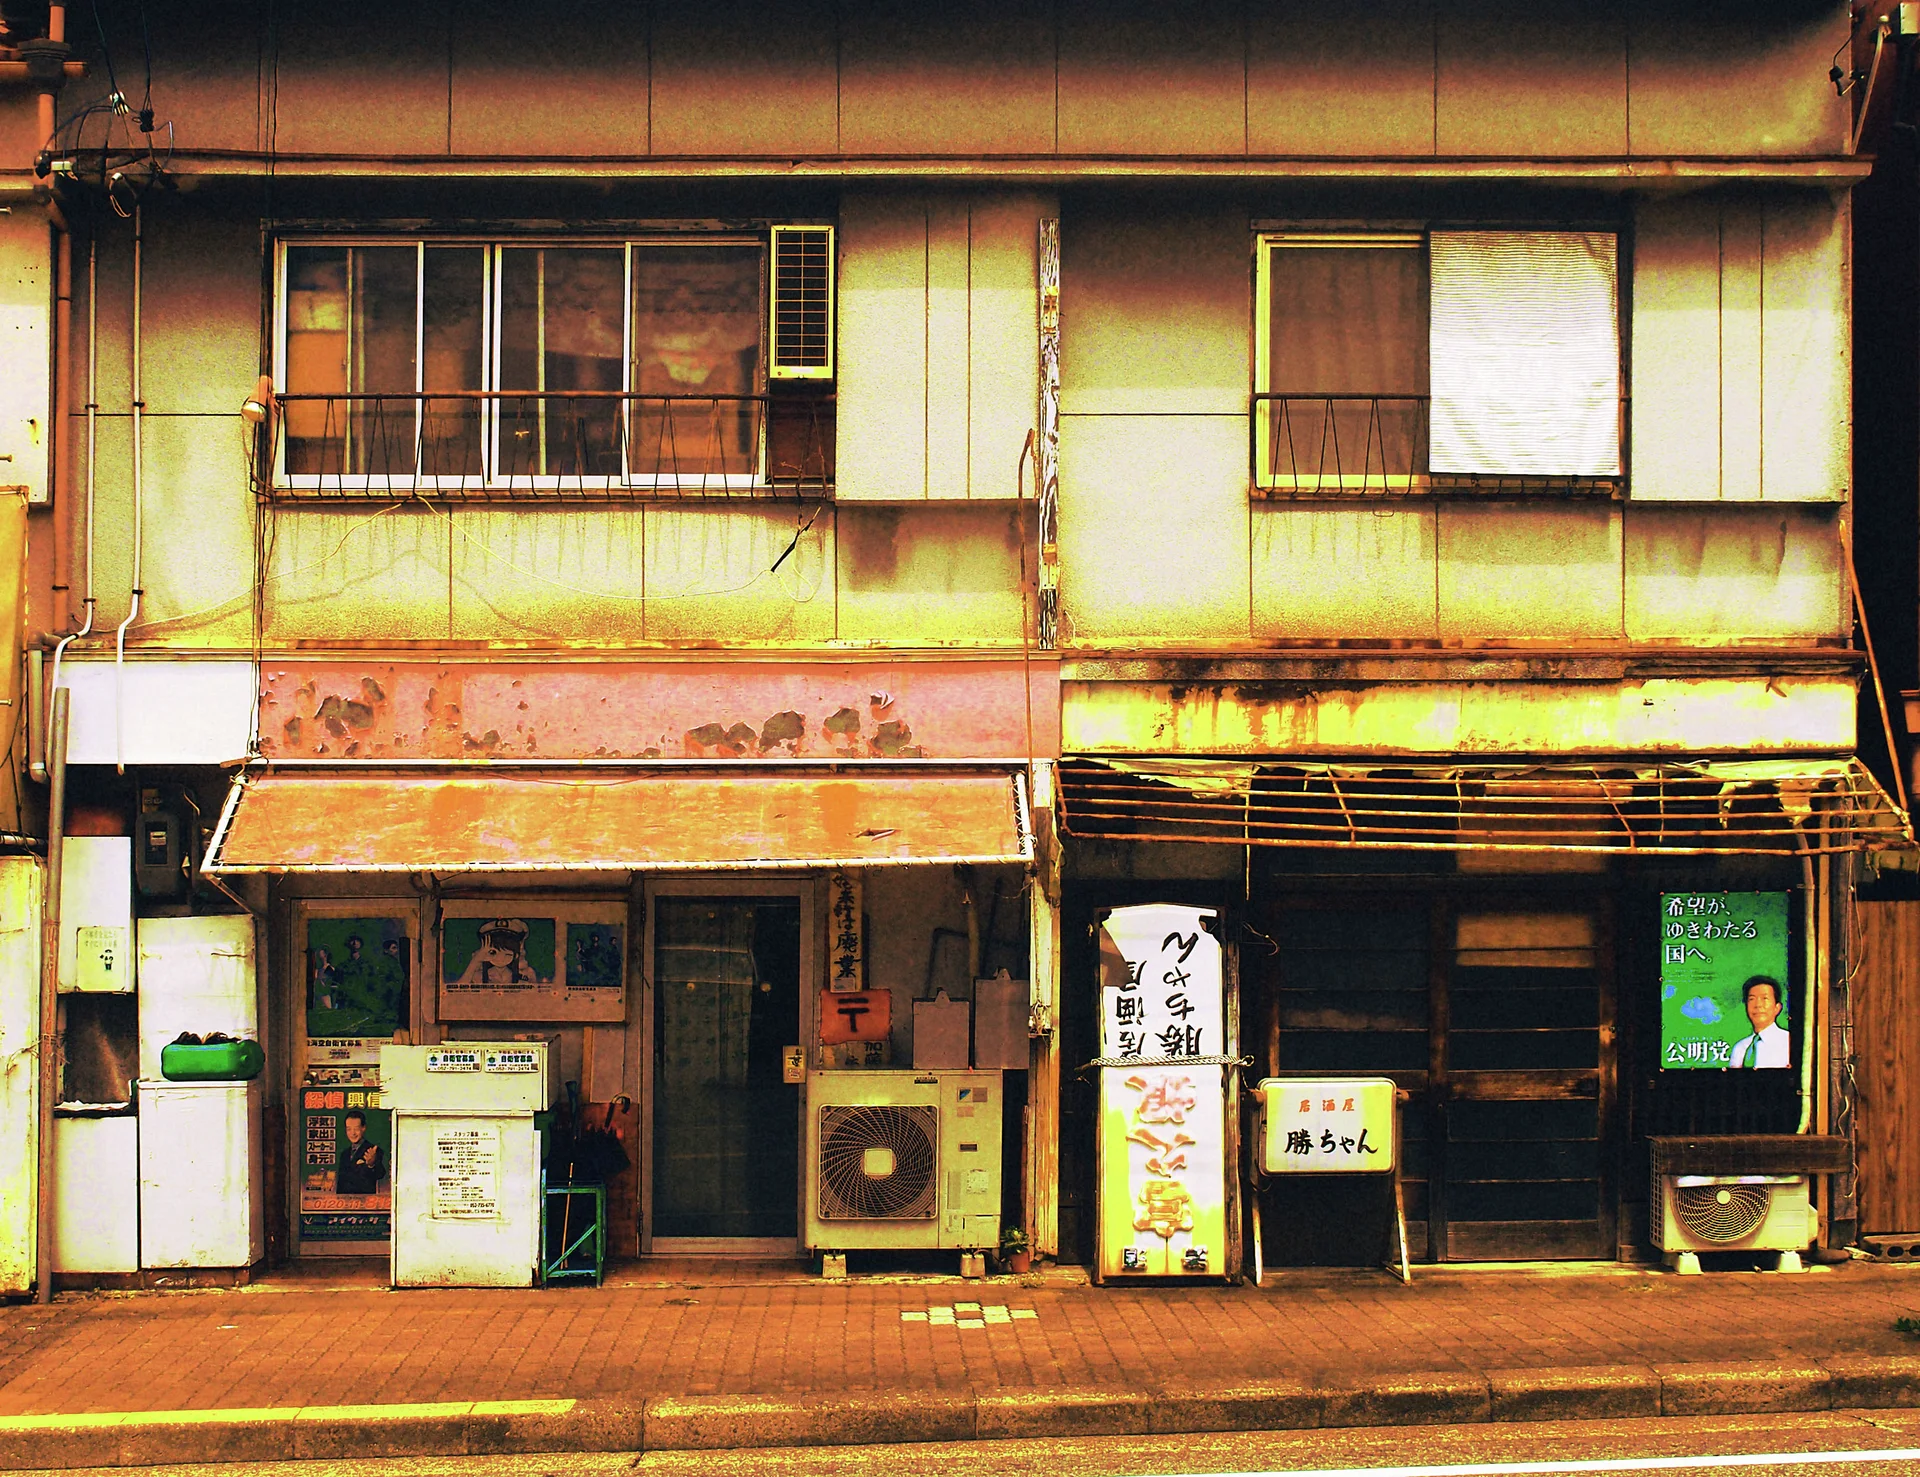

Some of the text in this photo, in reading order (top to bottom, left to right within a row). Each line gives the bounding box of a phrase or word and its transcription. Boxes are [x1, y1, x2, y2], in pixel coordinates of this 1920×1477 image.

[1665, 897, 1731, 916] 希望が、
[1665, 921, 1757, 939] ゆきわたる
[1665, 944, 1712, 964] 国へ。
[1155, 932, 1204, 1057] 勝ちゃん
[1666, 1041, 1731, 1063] 公明党
[305, 1091, 344, 1109] 探偵
[1298, 1098, 1355, 1113] 居酒屋
[1284, 1128, 1379, 1156] 勝ちゃん
